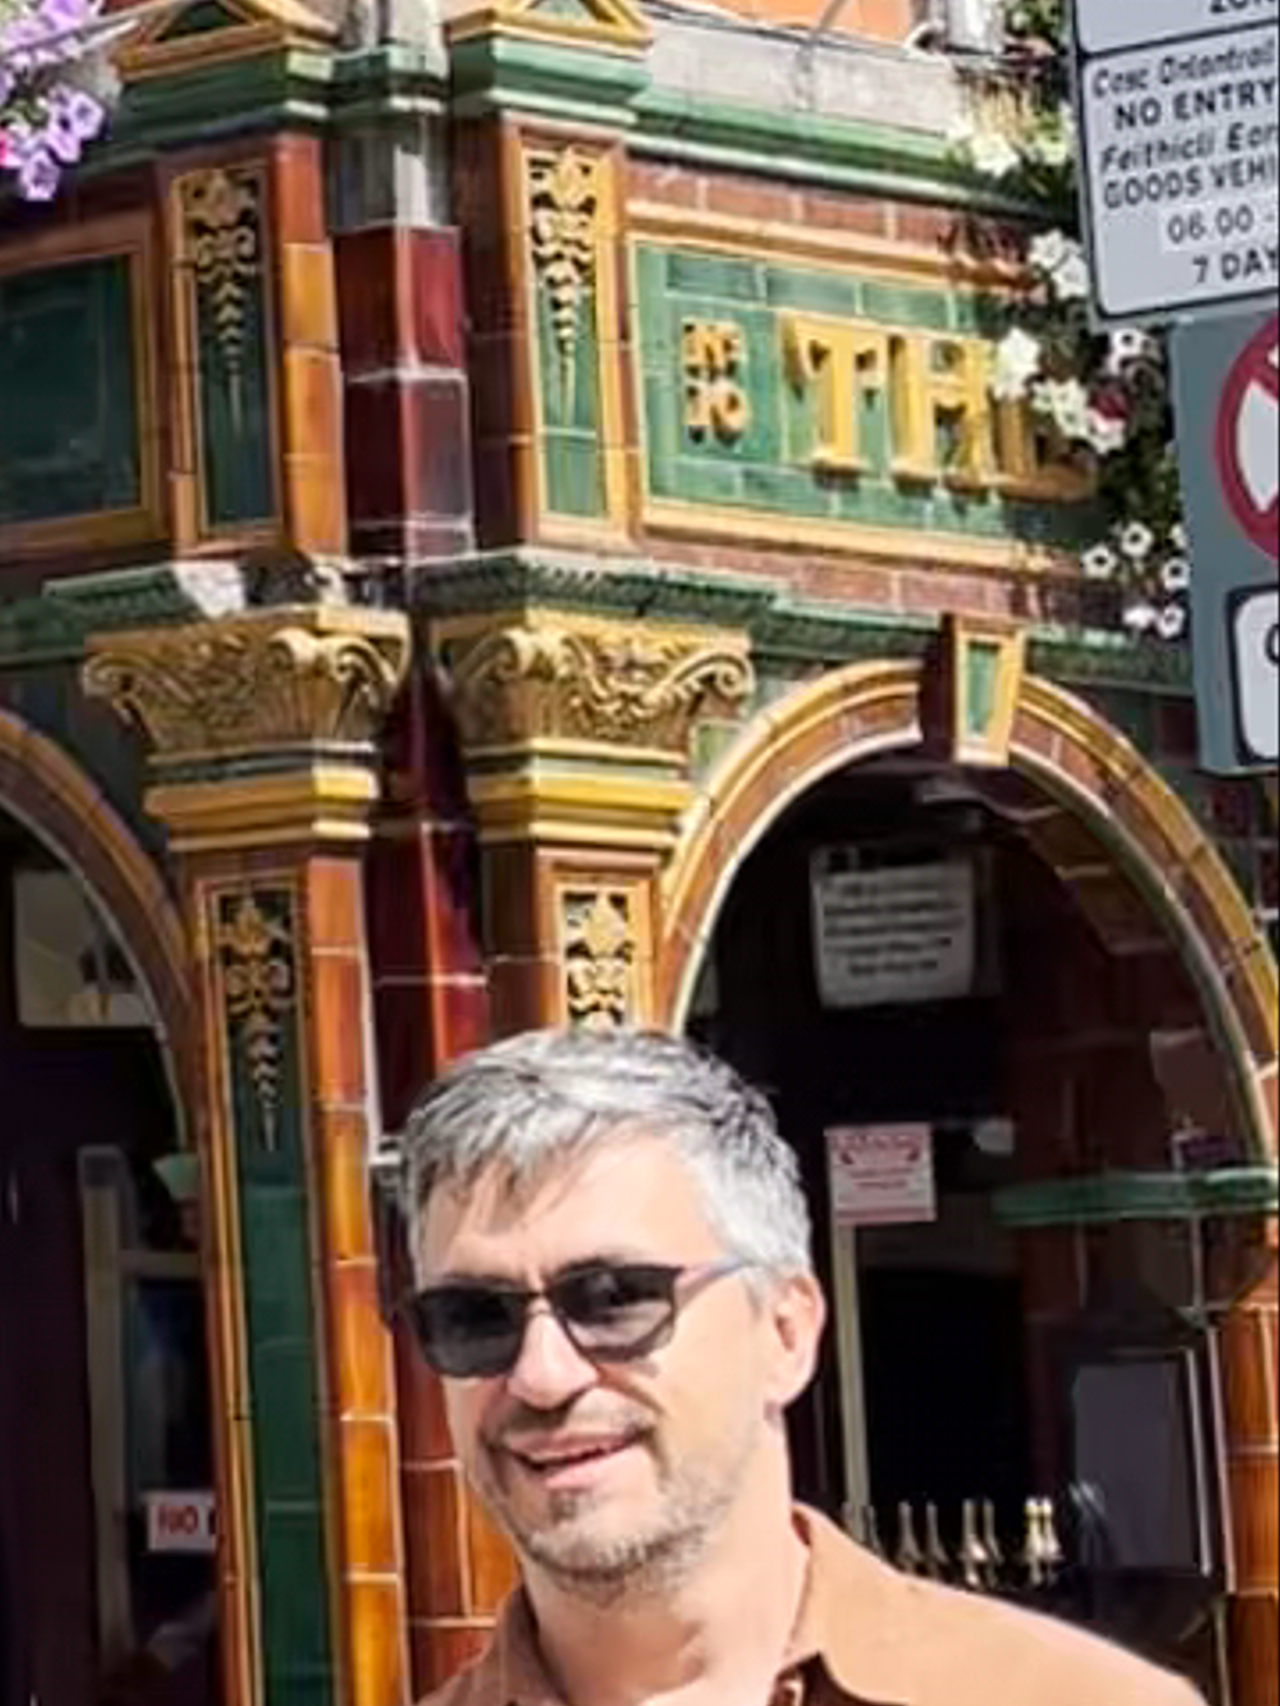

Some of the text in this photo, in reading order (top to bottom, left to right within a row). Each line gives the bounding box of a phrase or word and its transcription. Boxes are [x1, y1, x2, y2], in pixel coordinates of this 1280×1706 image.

[1113, 76, 1276, 131] NO ENTRY
[1104, 164, 1201, 210] GOODS
[1192, 255, 1209, 284] 7
